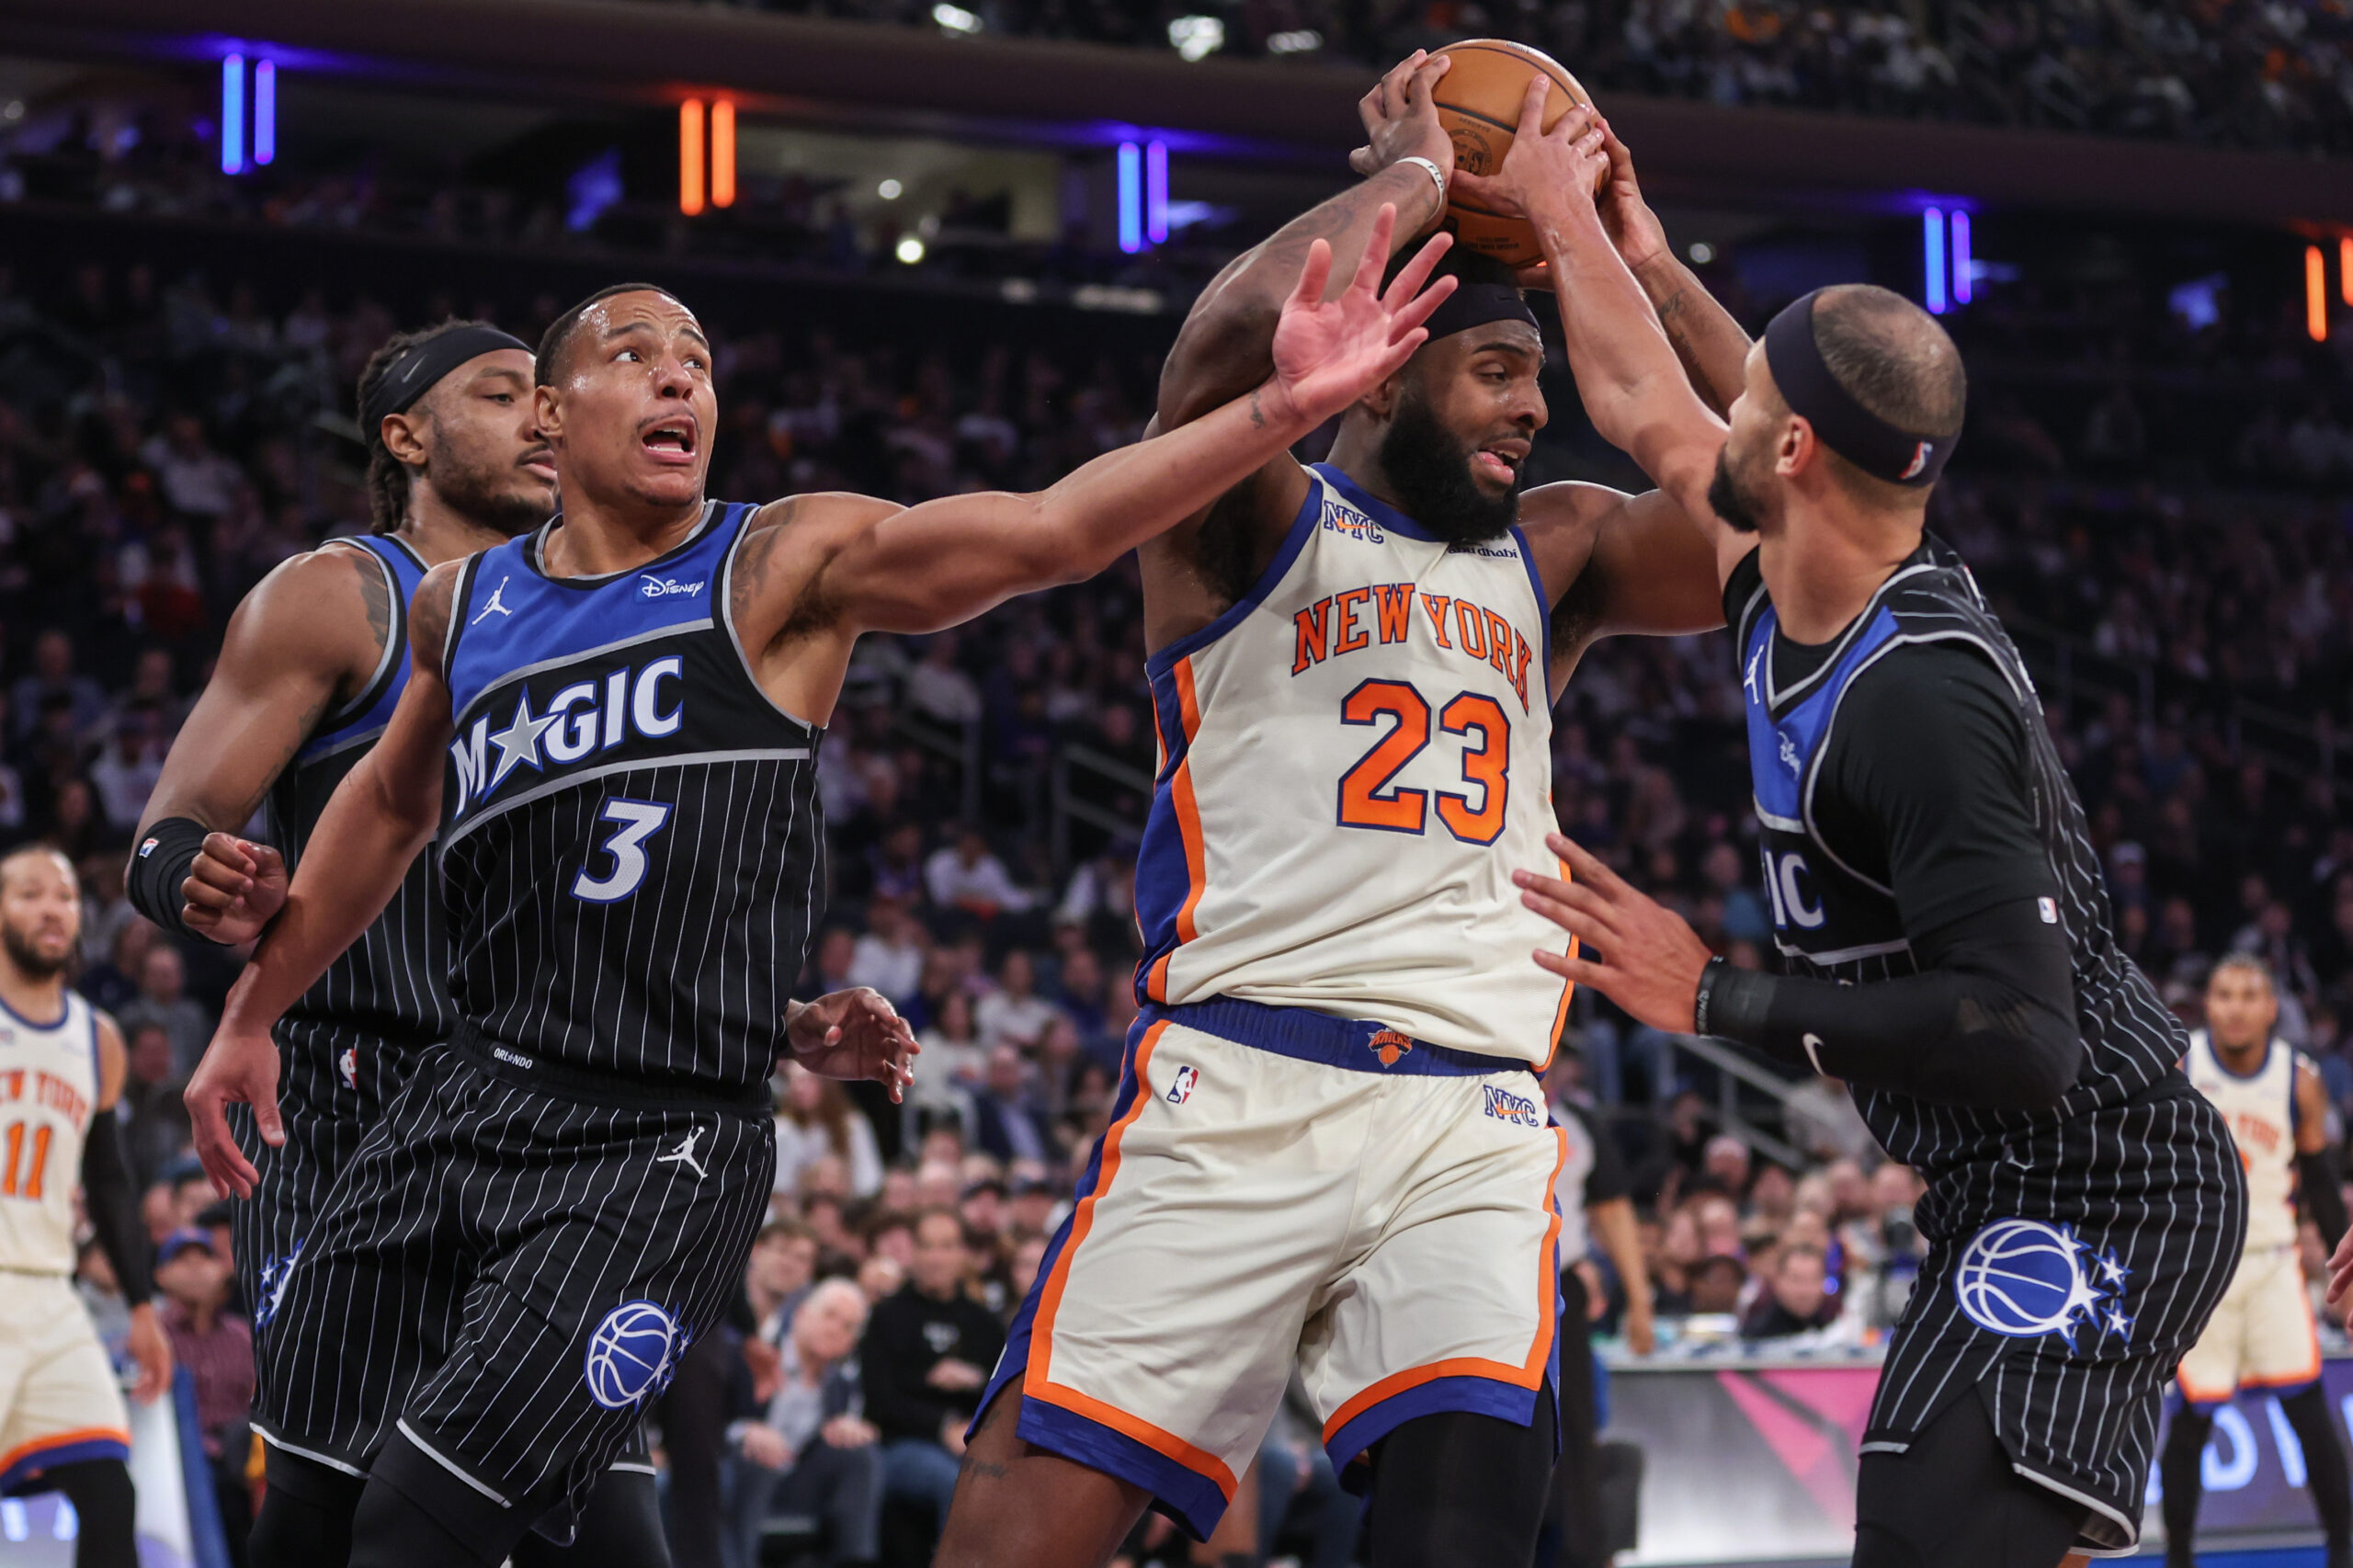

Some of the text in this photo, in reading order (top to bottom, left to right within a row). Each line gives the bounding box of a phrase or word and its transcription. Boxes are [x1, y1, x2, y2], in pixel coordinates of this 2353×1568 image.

[1324, 500, 1384, 544] NYC
[1477, 548, 1518, 559] dhabi
[641, 574, 705, 598] Disney
[1291, 583, 1532, 717] NEW YORK
[1336, 677, 1511, 846] 23
[568, 796, 674, 904] 3
[1483, 1084, 1540, 1128] NYC
[4, 1120, 52, 1199] 11
